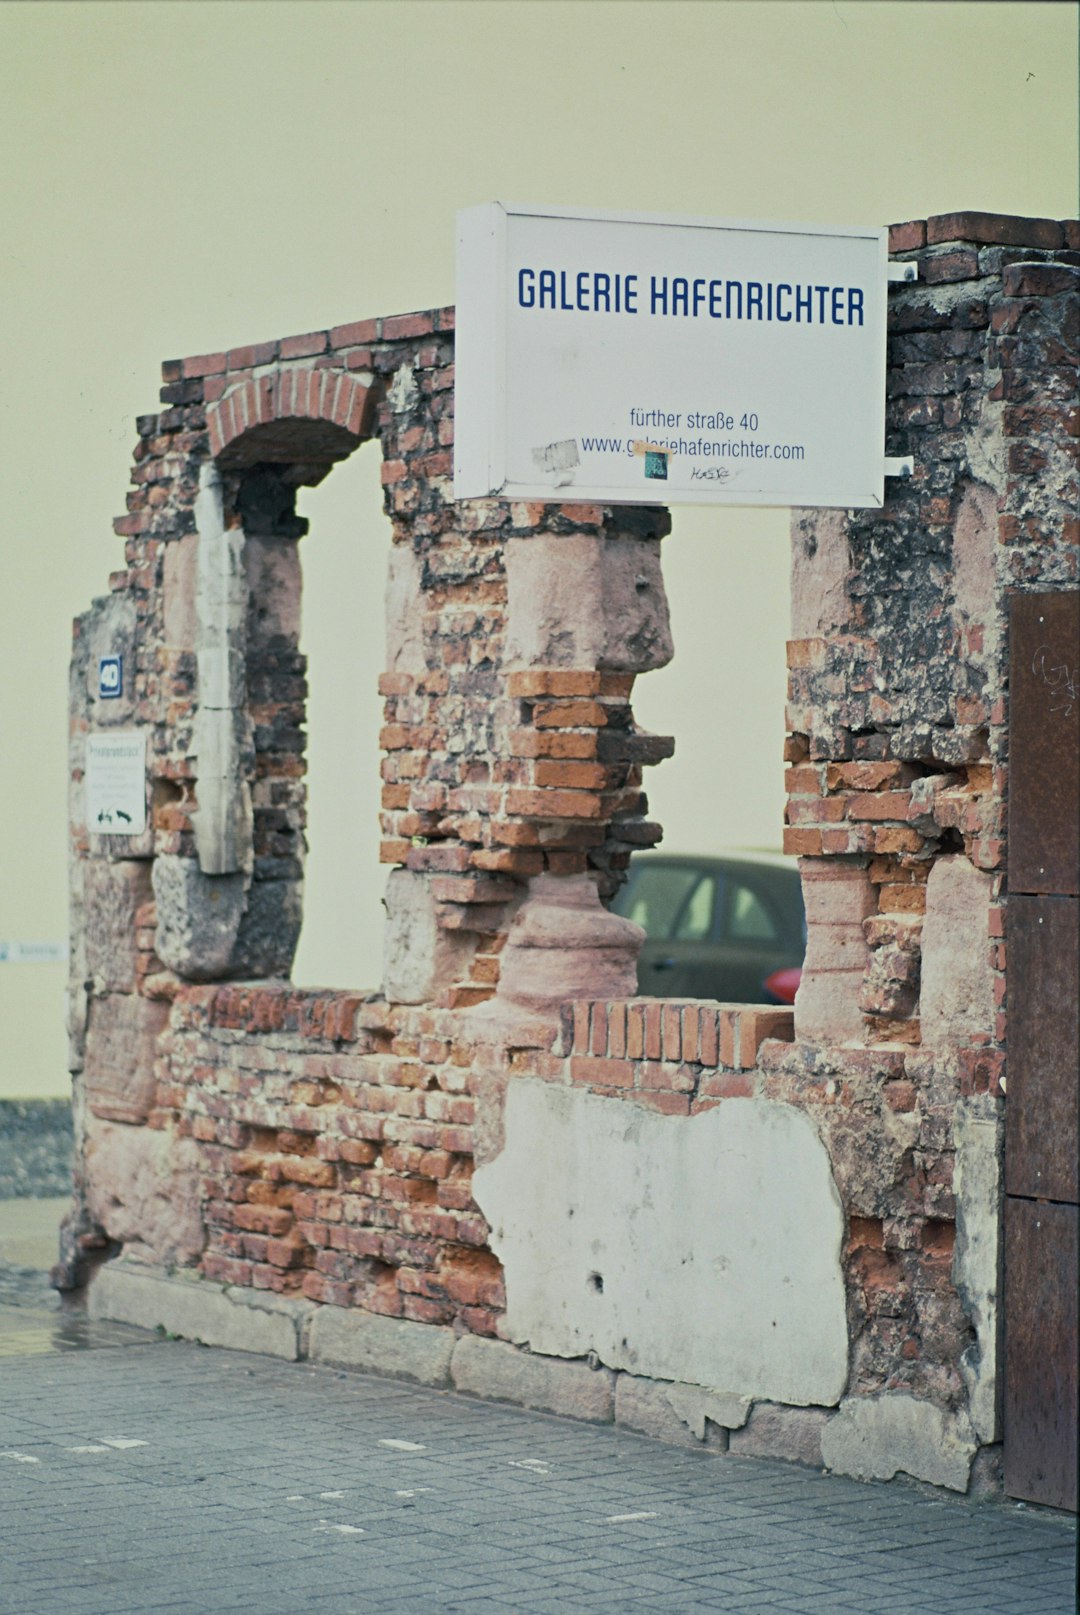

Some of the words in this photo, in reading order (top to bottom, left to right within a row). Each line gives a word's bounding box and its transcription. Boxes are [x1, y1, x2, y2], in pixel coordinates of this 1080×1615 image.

[518, 268, 638, 313] GALERIE
[651, 276, 863, 326] HAFENRICHTER
[631, 408, 681, 428] fürther
[687, 412, 734, 430] straße
[740, 414, 758, 431] 40
